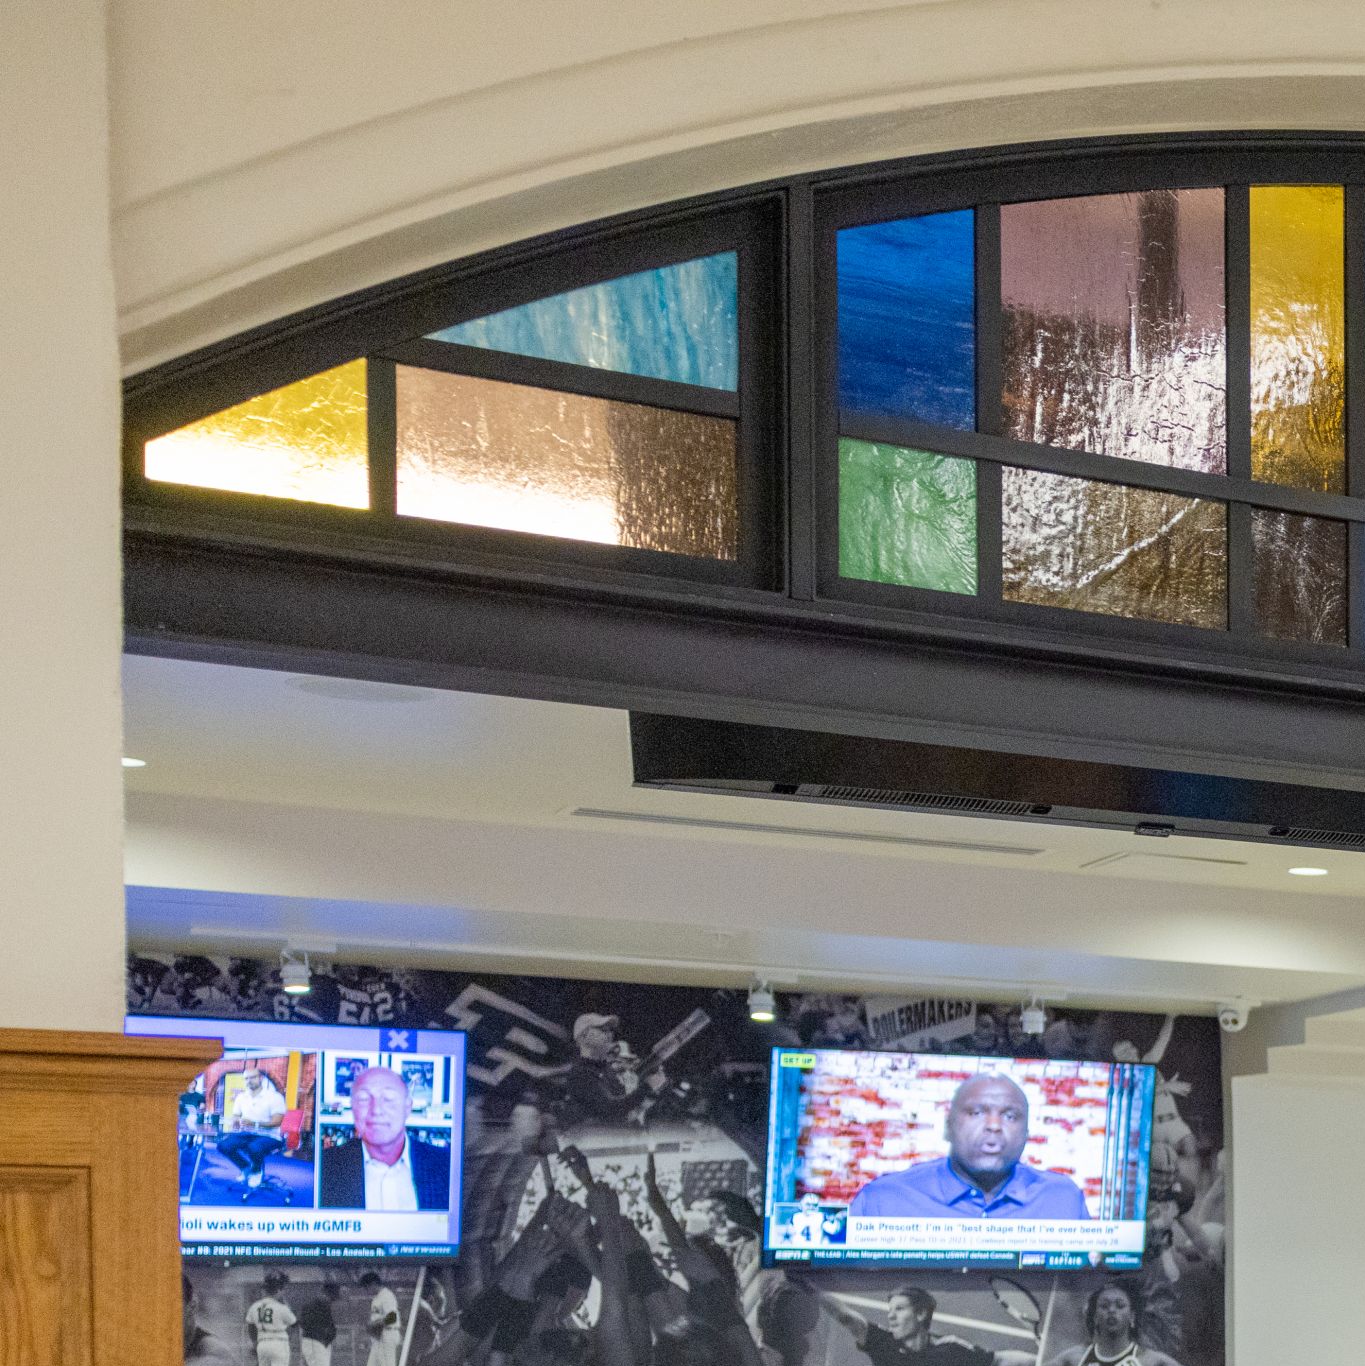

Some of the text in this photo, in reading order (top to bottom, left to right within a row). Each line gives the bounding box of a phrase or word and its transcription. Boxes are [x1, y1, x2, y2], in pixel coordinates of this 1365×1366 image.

[871, 1000, 973, 1041] BOILERMAKERS
[207, 1218, 253, 1231] wakes
[258, 1221, 276, 1234] up
[280, 1219, 309, 1231] with
[313, 1220, 362, 1233] #GMFB
[800, 1225, 812, 1241] 4
[855, 1221, 875, 1231] Dak
[926, 1222, 942, 1232] I'm
[944, 1223, 953, 1232] in
[957, 1223, 982, 1233] "best
[986, 1224, 1014, 1235] shape
[1017, 1224, 1036, 1234] that
[1039, 1224, 1055, 1234] I've
[1057, 1225, 1077, 1234] ever
[1079, 1225, 1102, 1235] been
[1105, 1224, 1120, 1235] in"
[976, 1237, 1005, 1245] Cowboys
[1007, 1237, 1028, 1245] report
[1038, 1238, 1064, 1246] training
[213, 1246, 233, 1255] 2021
[235, 1246, 251, 1255] NFC
[253, 1246, 293, 1256] Divisional
[294, 1247, 320, 1256] Round
[326, 1247, 341, 1257] Los
[343, 1247, 375, 1257] Angeles
[861, 1251, 889, 1260] Morgan's
[903, 1252, 927, 1260] penalty
[927, 1252, 945, 1260] helps
[1049, 1256, 1082, 1265] CAPTAIN
[257, 1306, 274, 1325] 18
